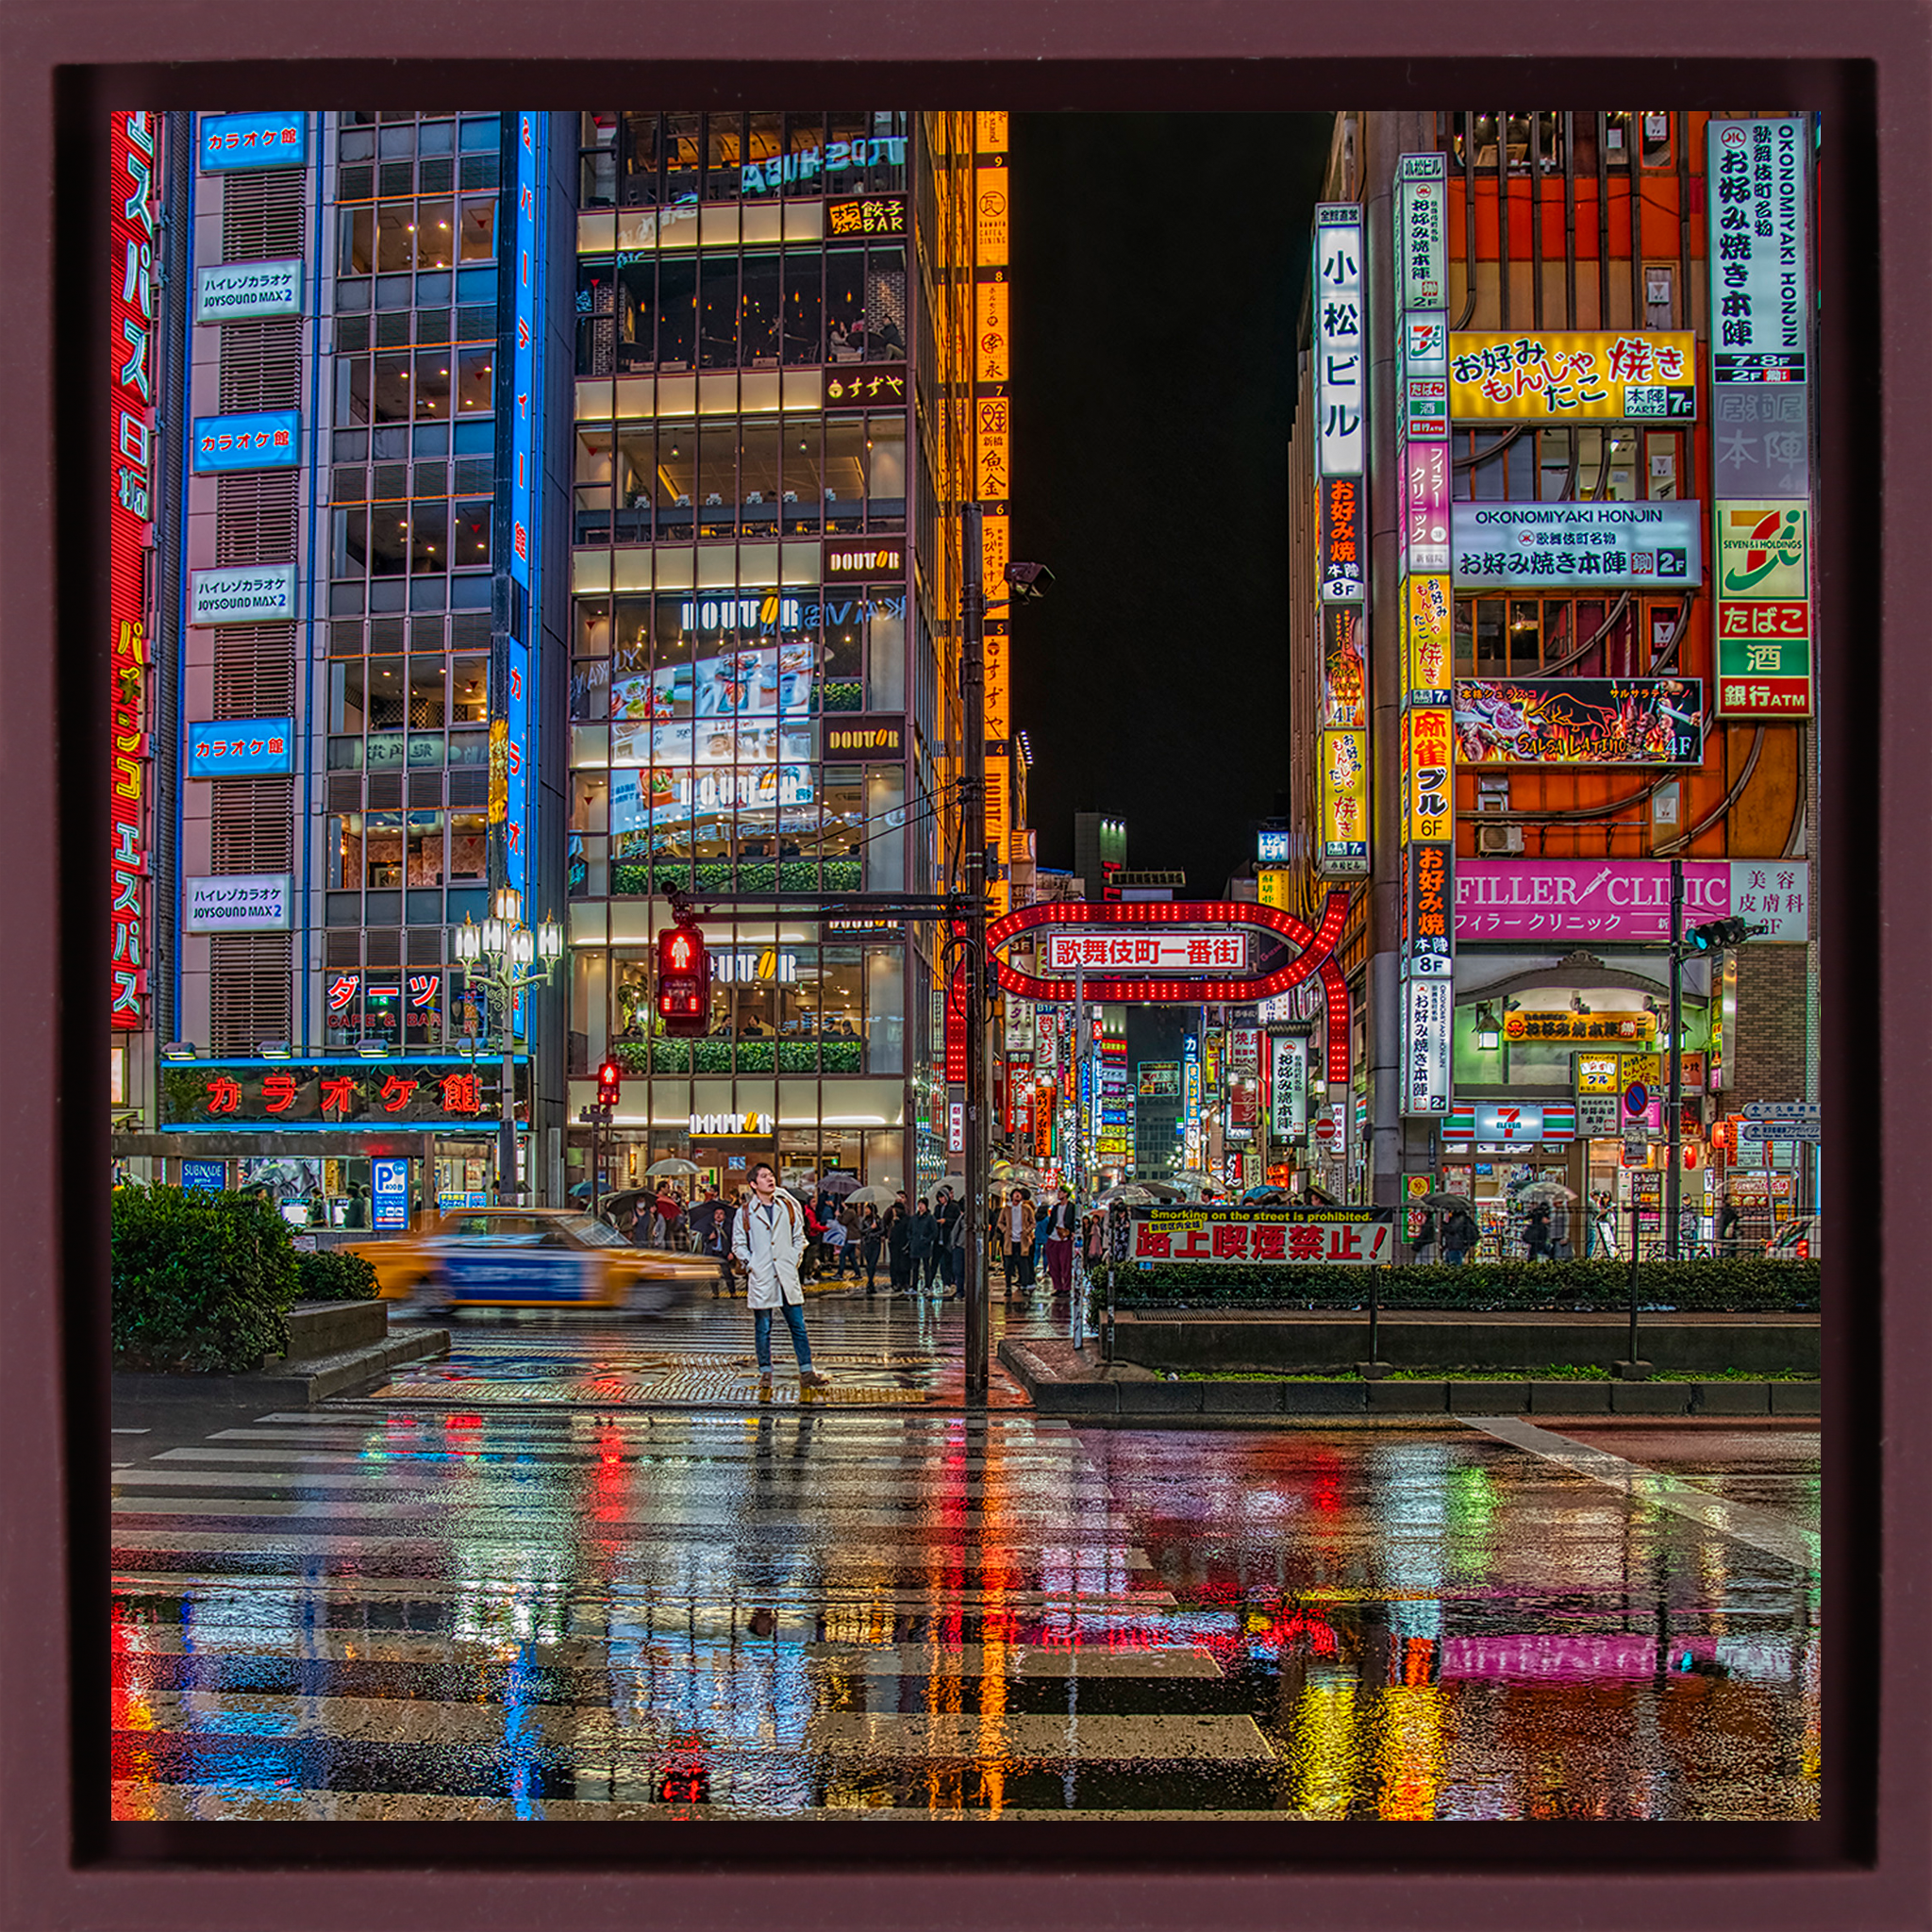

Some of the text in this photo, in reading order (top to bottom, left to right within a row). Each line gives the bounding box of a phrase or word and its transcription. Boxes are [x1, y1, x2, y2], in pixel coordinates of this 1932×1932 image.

[208, 128, 297, 150] カラオケ館
[1753, 125, 1774, 237] 歌舞伎町名物
[860, 200, 904, 218] 餃子
[862, 217, 904, 233] BAR
[1411, 199, 1431, 280] お好み焼本陣
[1778, 125, 1798, 347] OKONOMIYAKI HONJIN
[1718, 149, 1753, 347] お好み焼き本陣
[205, 274, 292, 291] ハイレゾカラオケ
[204, 293, 258, 308] JOYSOUND
[1412, 297, 1438, 307] 2F
[1323, 250, 1360, 438] 小松ビル
[1452, 339, 1545, 383] お好み
[1607, 337, 1684, 382] 焼き
[847, 375, 905, 398] すずや
[1482, 352, 1594, 403] もんじゃ
[1732, 371, 1761, 381] 2F
[1409, 381, 1445, 397] たばこ
[1543, 375, 1607, 412] たこ
[1627, 388, 1665, 404] 本陣
[1419, 401, 1436, 415] 酒
[1626, 405, 1666, 415] PART2
[1669, 391, 1692, 414] 7F
[202, 430, 290, 452] カラオケ館
[1719, 429, 1805, 470] 本陣
[980, 450, 1007, 497] 魚金
[1430, 448, 1443, 508] フィラー
[995, 503, 1005, 516] 6
[1410, 467, 1427, 543] クリニック
[1330, 479, 1357, 562] お好み焼
[1475, 509, 1663, 525] OKONOMIYAKI HONJIN
[830, 550, 900, 572] DOUTOR
[1327, 563, 1360, 578] 本陣
[1460, 551, 1627, 575] お好み焼き本陣
[1658, 552, 1685, 573] 2F
[198, 578, 286, 595] ハイレゾカラオケ
[1332, 582, 1356, 596] 8F
[197, 597, 251, 611] JOYSOUND
[996, 624, 1005, 635] 5
[1413, 614, 1430, 641] たこ
[1724, 607, 1804, 634] たばこ
[1418, 641, 1444, 687] 焼き
[1746, 644, 1782, 672] 酒
[1434, 690, 1449, 704] 7F
[1462, 690, 1538, 699] 本格シュラスコ
[1610, 689, 1690, 699] サルサラティーノ
[1724, 685, 1806, 708] 銀行ATM
[1333, 706, 1357, 724] 4F
[196, 737, 284, 758] カラオケ館
[829, 727, 899, 749] DOUTOR
[1665, 737, 1691, 756] 4F
[995, 744, 1006, 756] 4
[1413, 711, 1449, 816] 麻雀ブル
[1328, 769, 1344, 793] たこ
[1333, 795, 1357, 838] 焼き
[1421, 820, 1443, 837] 6F
[1349, 842, 1362, 855] 7F
[1455, 876, 1577, 906] FILLER
[1747, 870, 1796, 891] 美容
[193, 888, 281, 902] ハイレゾカラオケ
[1418, 847, 1445, 936] お好み焼
[193, 906, 246, 919] JOYSOUND
[1738, 892, 1806, 914] 皮膚科
[112, 822, 142, 1015] エスパス
[1455, 914, 1521, 931] フィラー
[1528, 914, 1622, 931] クリニック
[1657, 917, 1697, 930] 新院
[1056, 939, 1240, 965] 歌舞伎町一番街
[1415, 937, 1449, 954] 本陣
[1419, 957, 1443, 973] 8F
[328, 975, 440, 1011] ダーツ
[327, 1014, 376, 1027] CAFE
[407, 1013, 441, 1027] BAR
[1413, 995, 1429, 1096] お好み焼き本陣
[207, 1073, 481, 1114] カラオケ館
[1151, 1209, 1374, 1224] Smorking on the street is prohibited.
